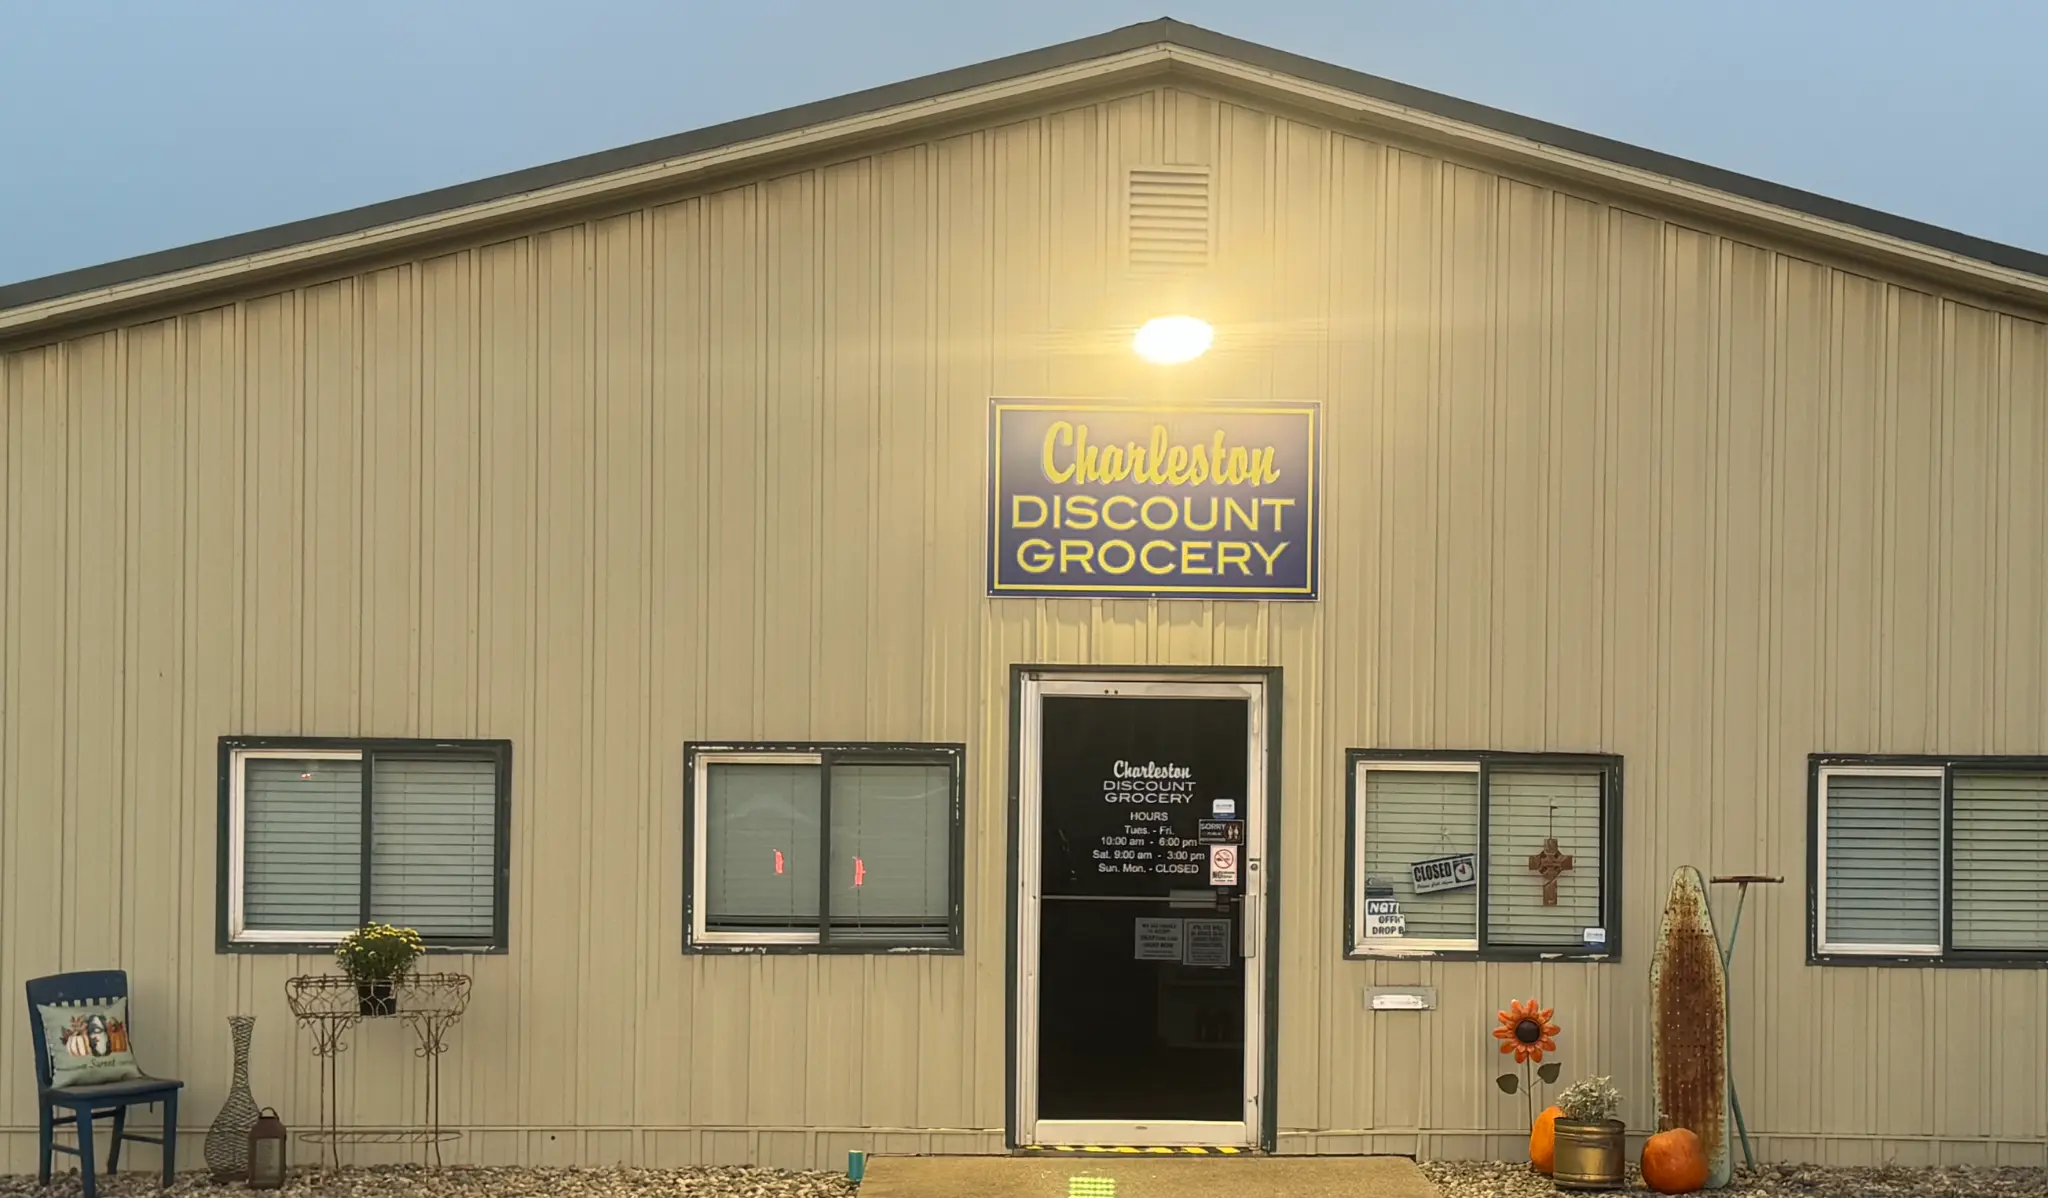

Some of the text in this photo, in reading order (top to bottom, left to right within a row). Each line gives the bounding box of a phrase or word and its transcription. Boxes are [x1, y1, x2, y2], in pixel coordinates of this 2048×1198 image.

[1042, 420, 1281, 487] Charleston
[1012, 493, 1296, 532] DISCOUNT
[1016, 537, 1291, 576] GROCERY
[1113, 759, 1192, 779] Charleston
[1103, 781, 1196, 792] DISCOUNT
[1105, 793, 1194, 804] GROCERY
[1130, 812, 1168, 821] HOURS
[1124, 825, 1150, 835] Tues.
[1159, 826, 1175, 835] Fri.
[1101, 836, 1127, 846] 10:00
[1129, 838, 1145, 846] am
[1159, 837, 1180, 846] 6:00
[1182, 839, 1197, 848] pm
[1092, 849, 1111, 859] Sat.
[1114, 850, 1135, 859] 9:00
[1137, 851, 1152, 859] am
[1167, 851, 1188, 860] 3:00
[1190, 852, 1205, 861] pm
[1098, 863, 1120, 873] Sun.
[1123, 863, 1146, 873] Mon.
[1155, 864, 1199, 873] CLOSED
[1413, 862, 1452, 882] CLOSED
[1372, 926, 1396, 935] DROP
